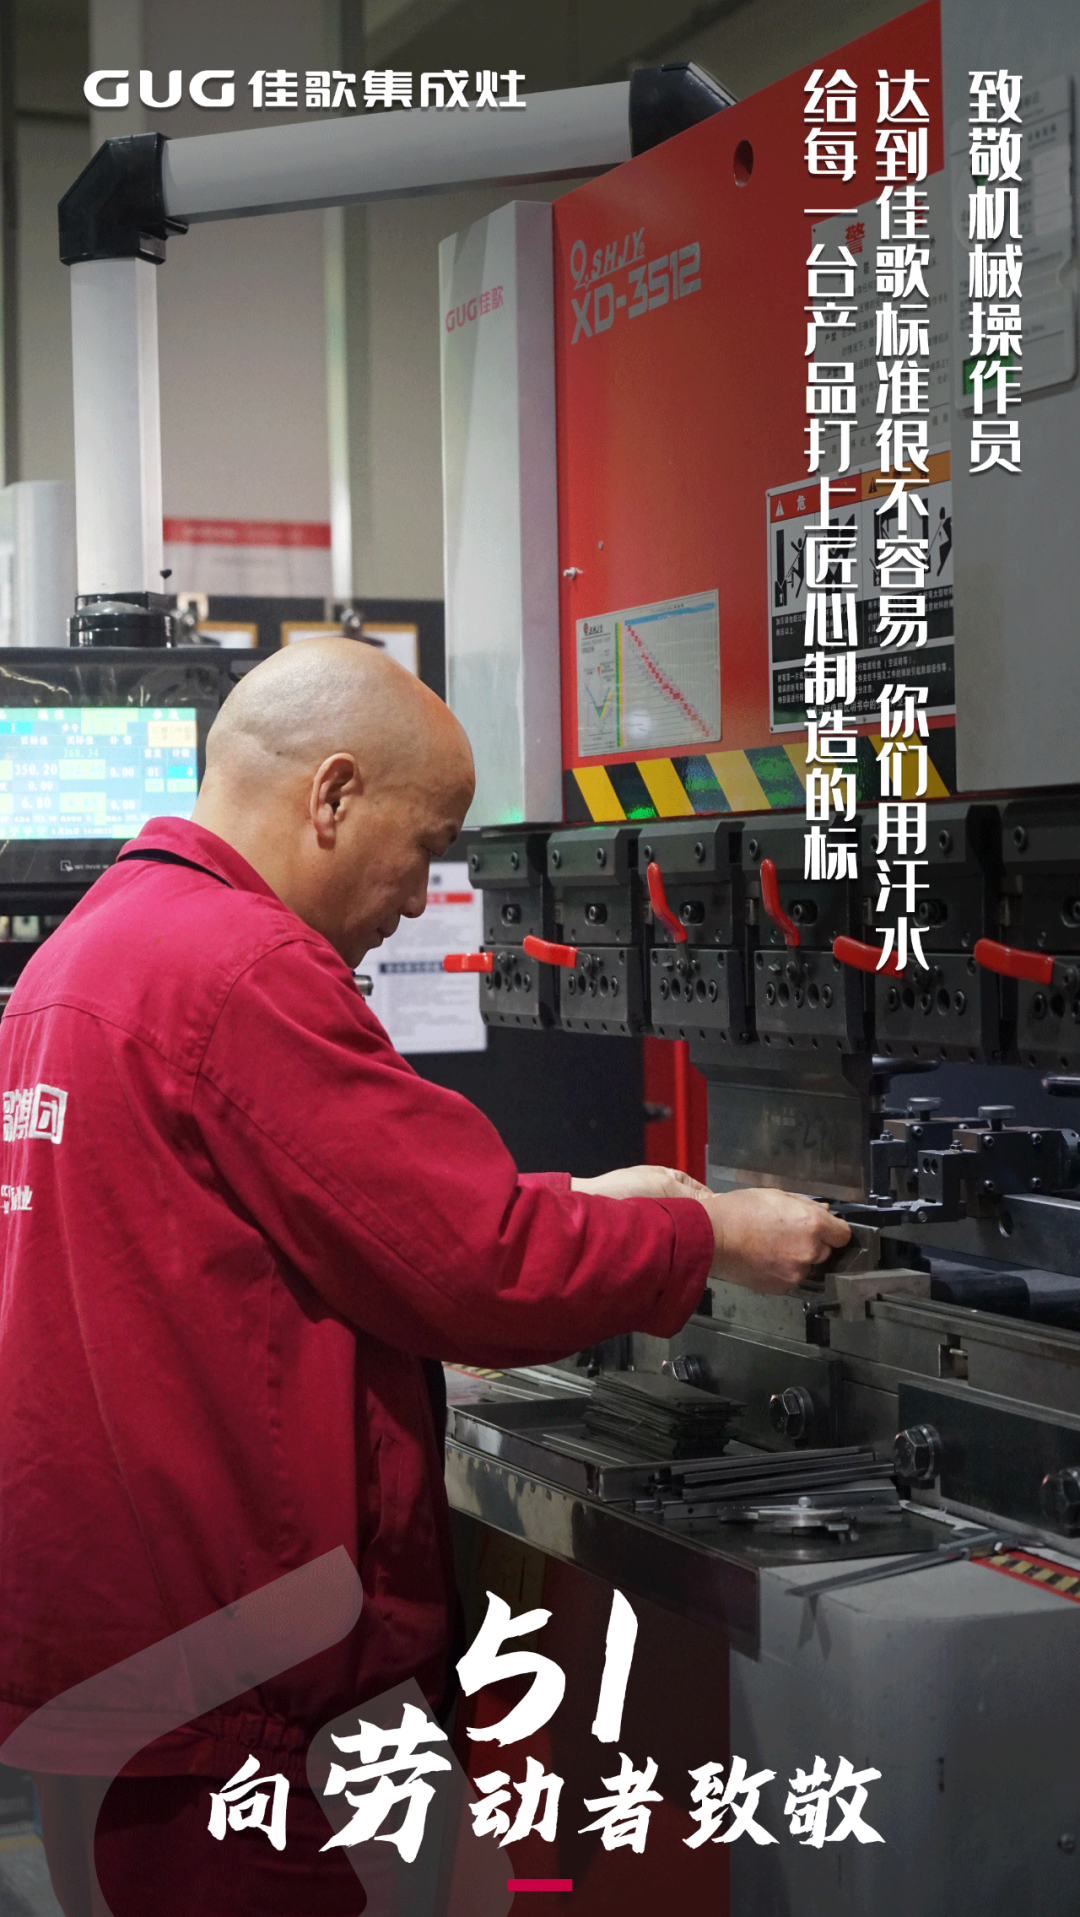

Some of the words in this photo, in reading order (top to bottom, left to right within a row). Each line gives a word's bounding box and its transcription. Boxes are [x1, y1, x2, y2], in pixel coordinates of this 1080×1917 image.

[571, 241, 702, 344] XD-3512
[445, 297, 478, 332] GUG
[479, 285, 504, 315] 佳歌
[14, 763, 58, 776] 350.20
[28, 780, 53, 790] 0.00
[21, 797, 51, 808] 6.80
